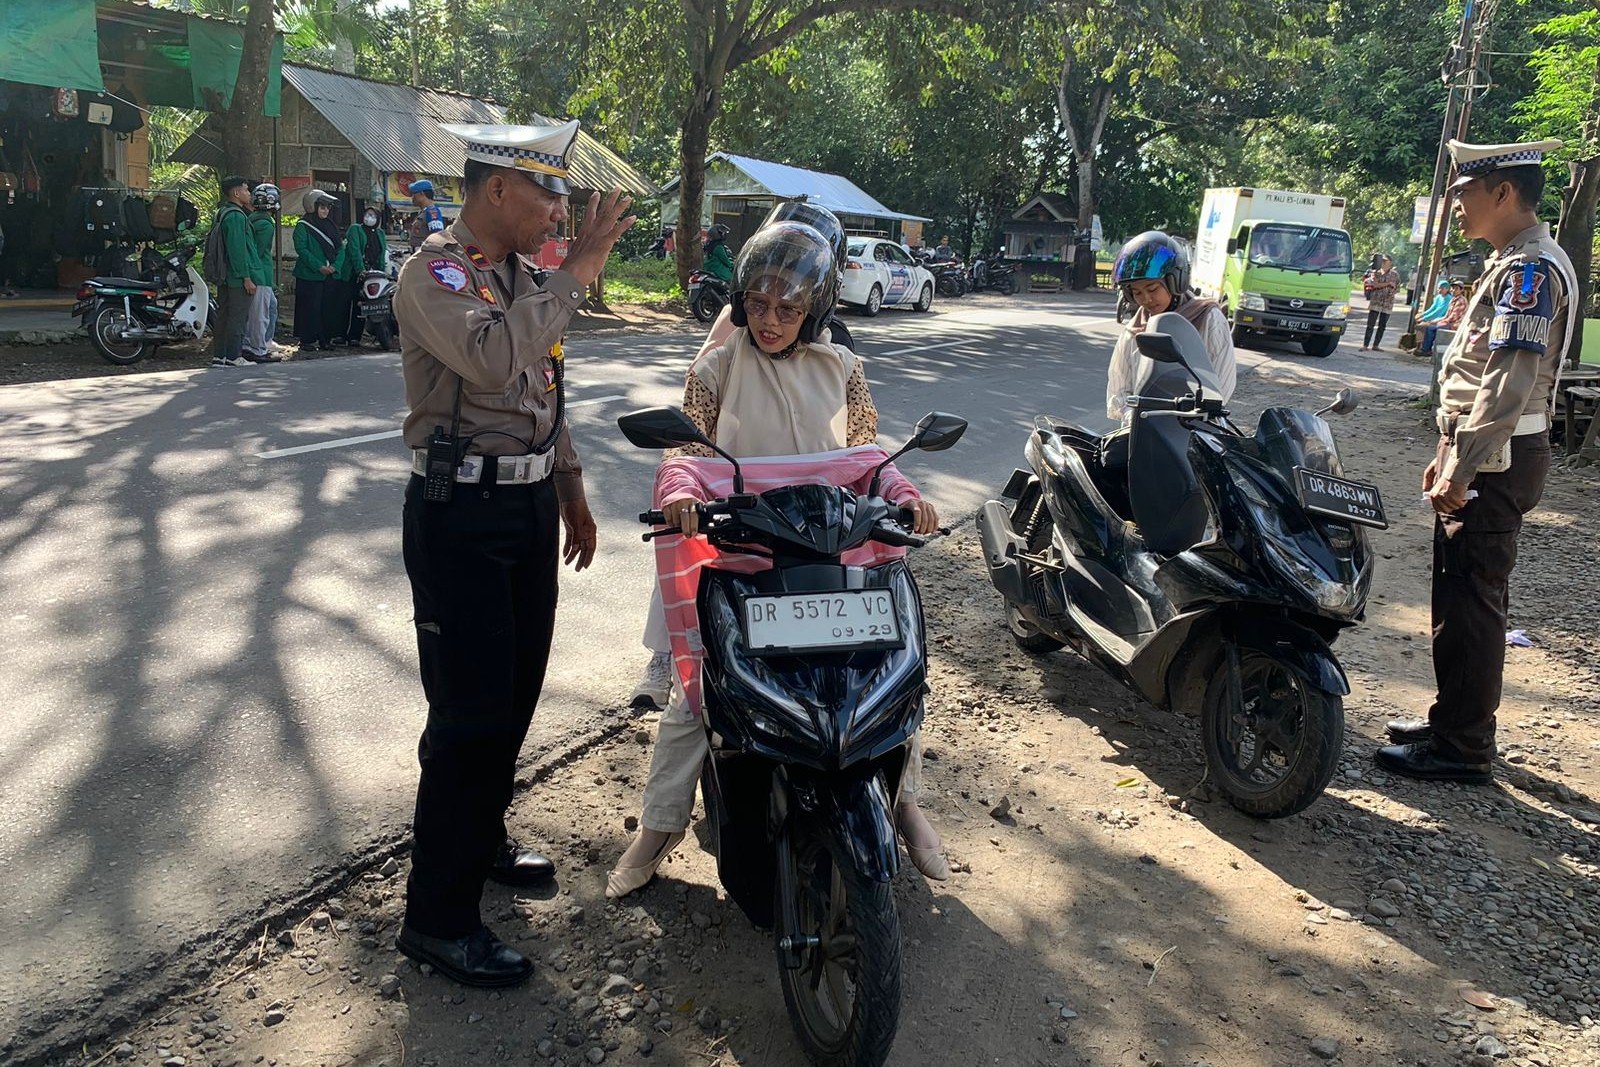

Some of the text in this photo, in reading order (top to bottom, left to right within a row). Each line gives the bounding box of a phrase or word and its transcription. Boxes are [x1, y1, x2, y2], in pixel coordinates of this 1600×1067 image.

[1490, 313, 1551, 348] ATWA
[1309, 477, 1374, 506] DR 4863 MV
[752, 596, 889, 622] DR 5572 VC
